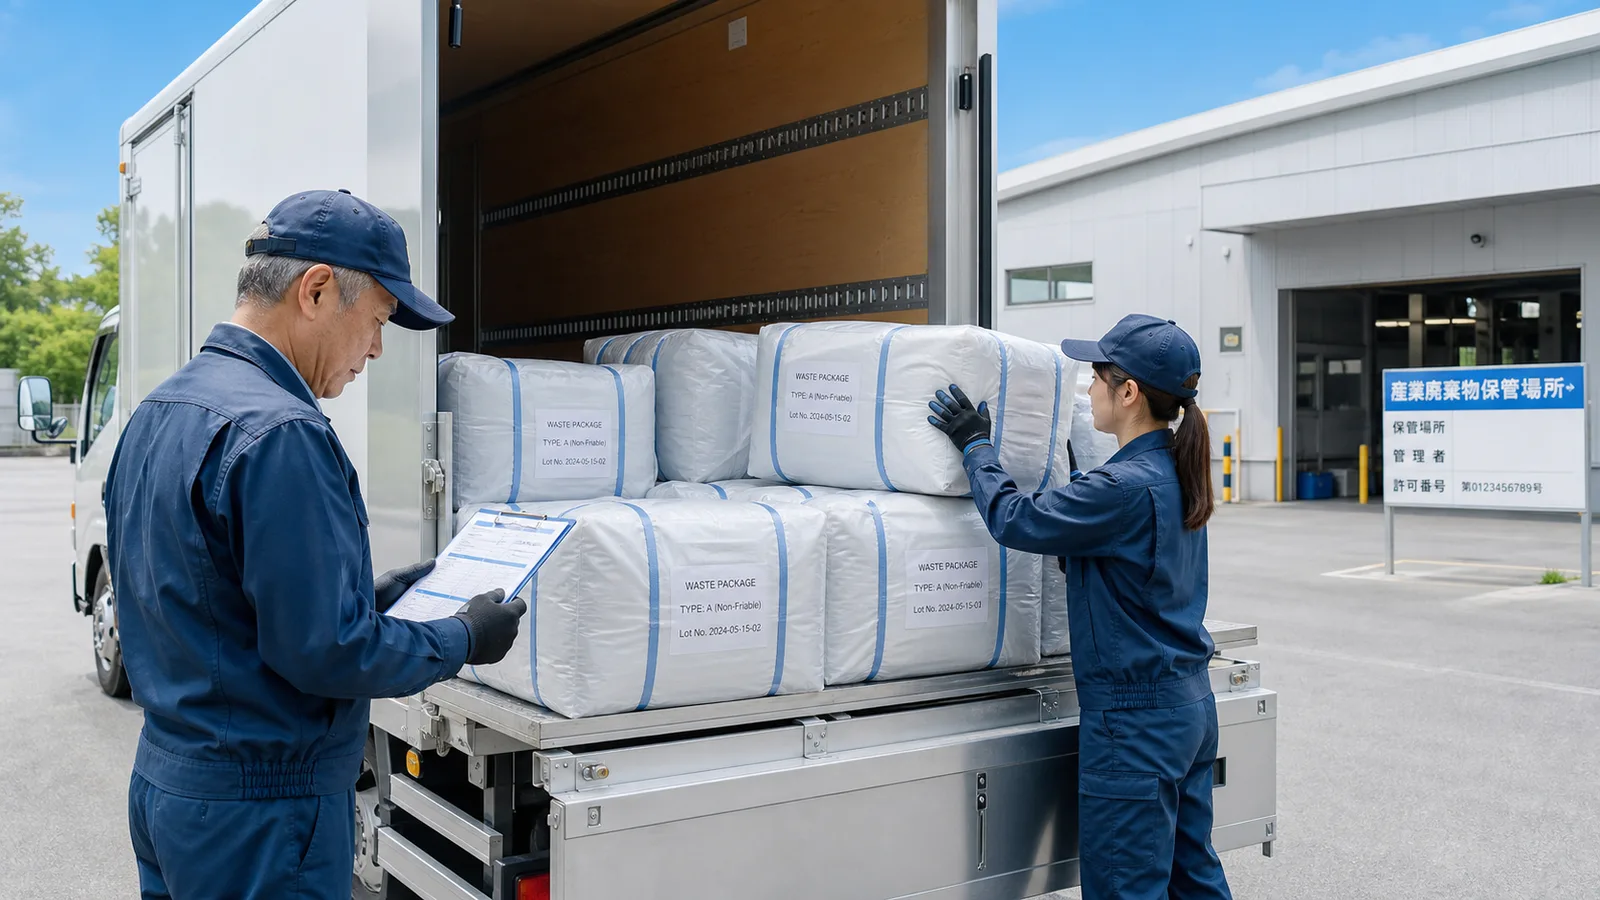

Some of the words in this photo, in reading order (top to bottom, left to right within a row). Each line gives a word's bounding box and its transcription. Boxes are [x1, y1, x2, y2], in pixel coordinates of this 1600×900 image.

[796, 373, 817, 381] WASTE
[819, 373, 849, 382] PACKAGE
[1391, 377, 1565, 402] 産業廃棄物保管場所
[789, 411, 798, 419] Lot
[1392, 420, 1446, 435] 保管場所
[1393, 478, 1446, 493] 許可番号
[1461, 481, 1543, 494] 第0123456789号
[918, 562, 944, 571] WASTE
[945, 560, 978, 570] PACKAGE
[685, 580, 715, 590] WASTE
[717, 578, 756, 589] PACKAGE
[914, 583, 935, 592] TYPE:
[936, 583, 942, 591] A
[942, 580, 983, 592] (Non-Friable)
[680, 604, 705, 614] TYPE:
[706, 603, 713, 612] A
[714, 600, 762, 613] (Non-Friable)
[913, 606, 924, 614] Lot
[925, 605, 937, 613] No.
[679, 629, 692, 638] Lot
[694, 628, 707, 637] No.
